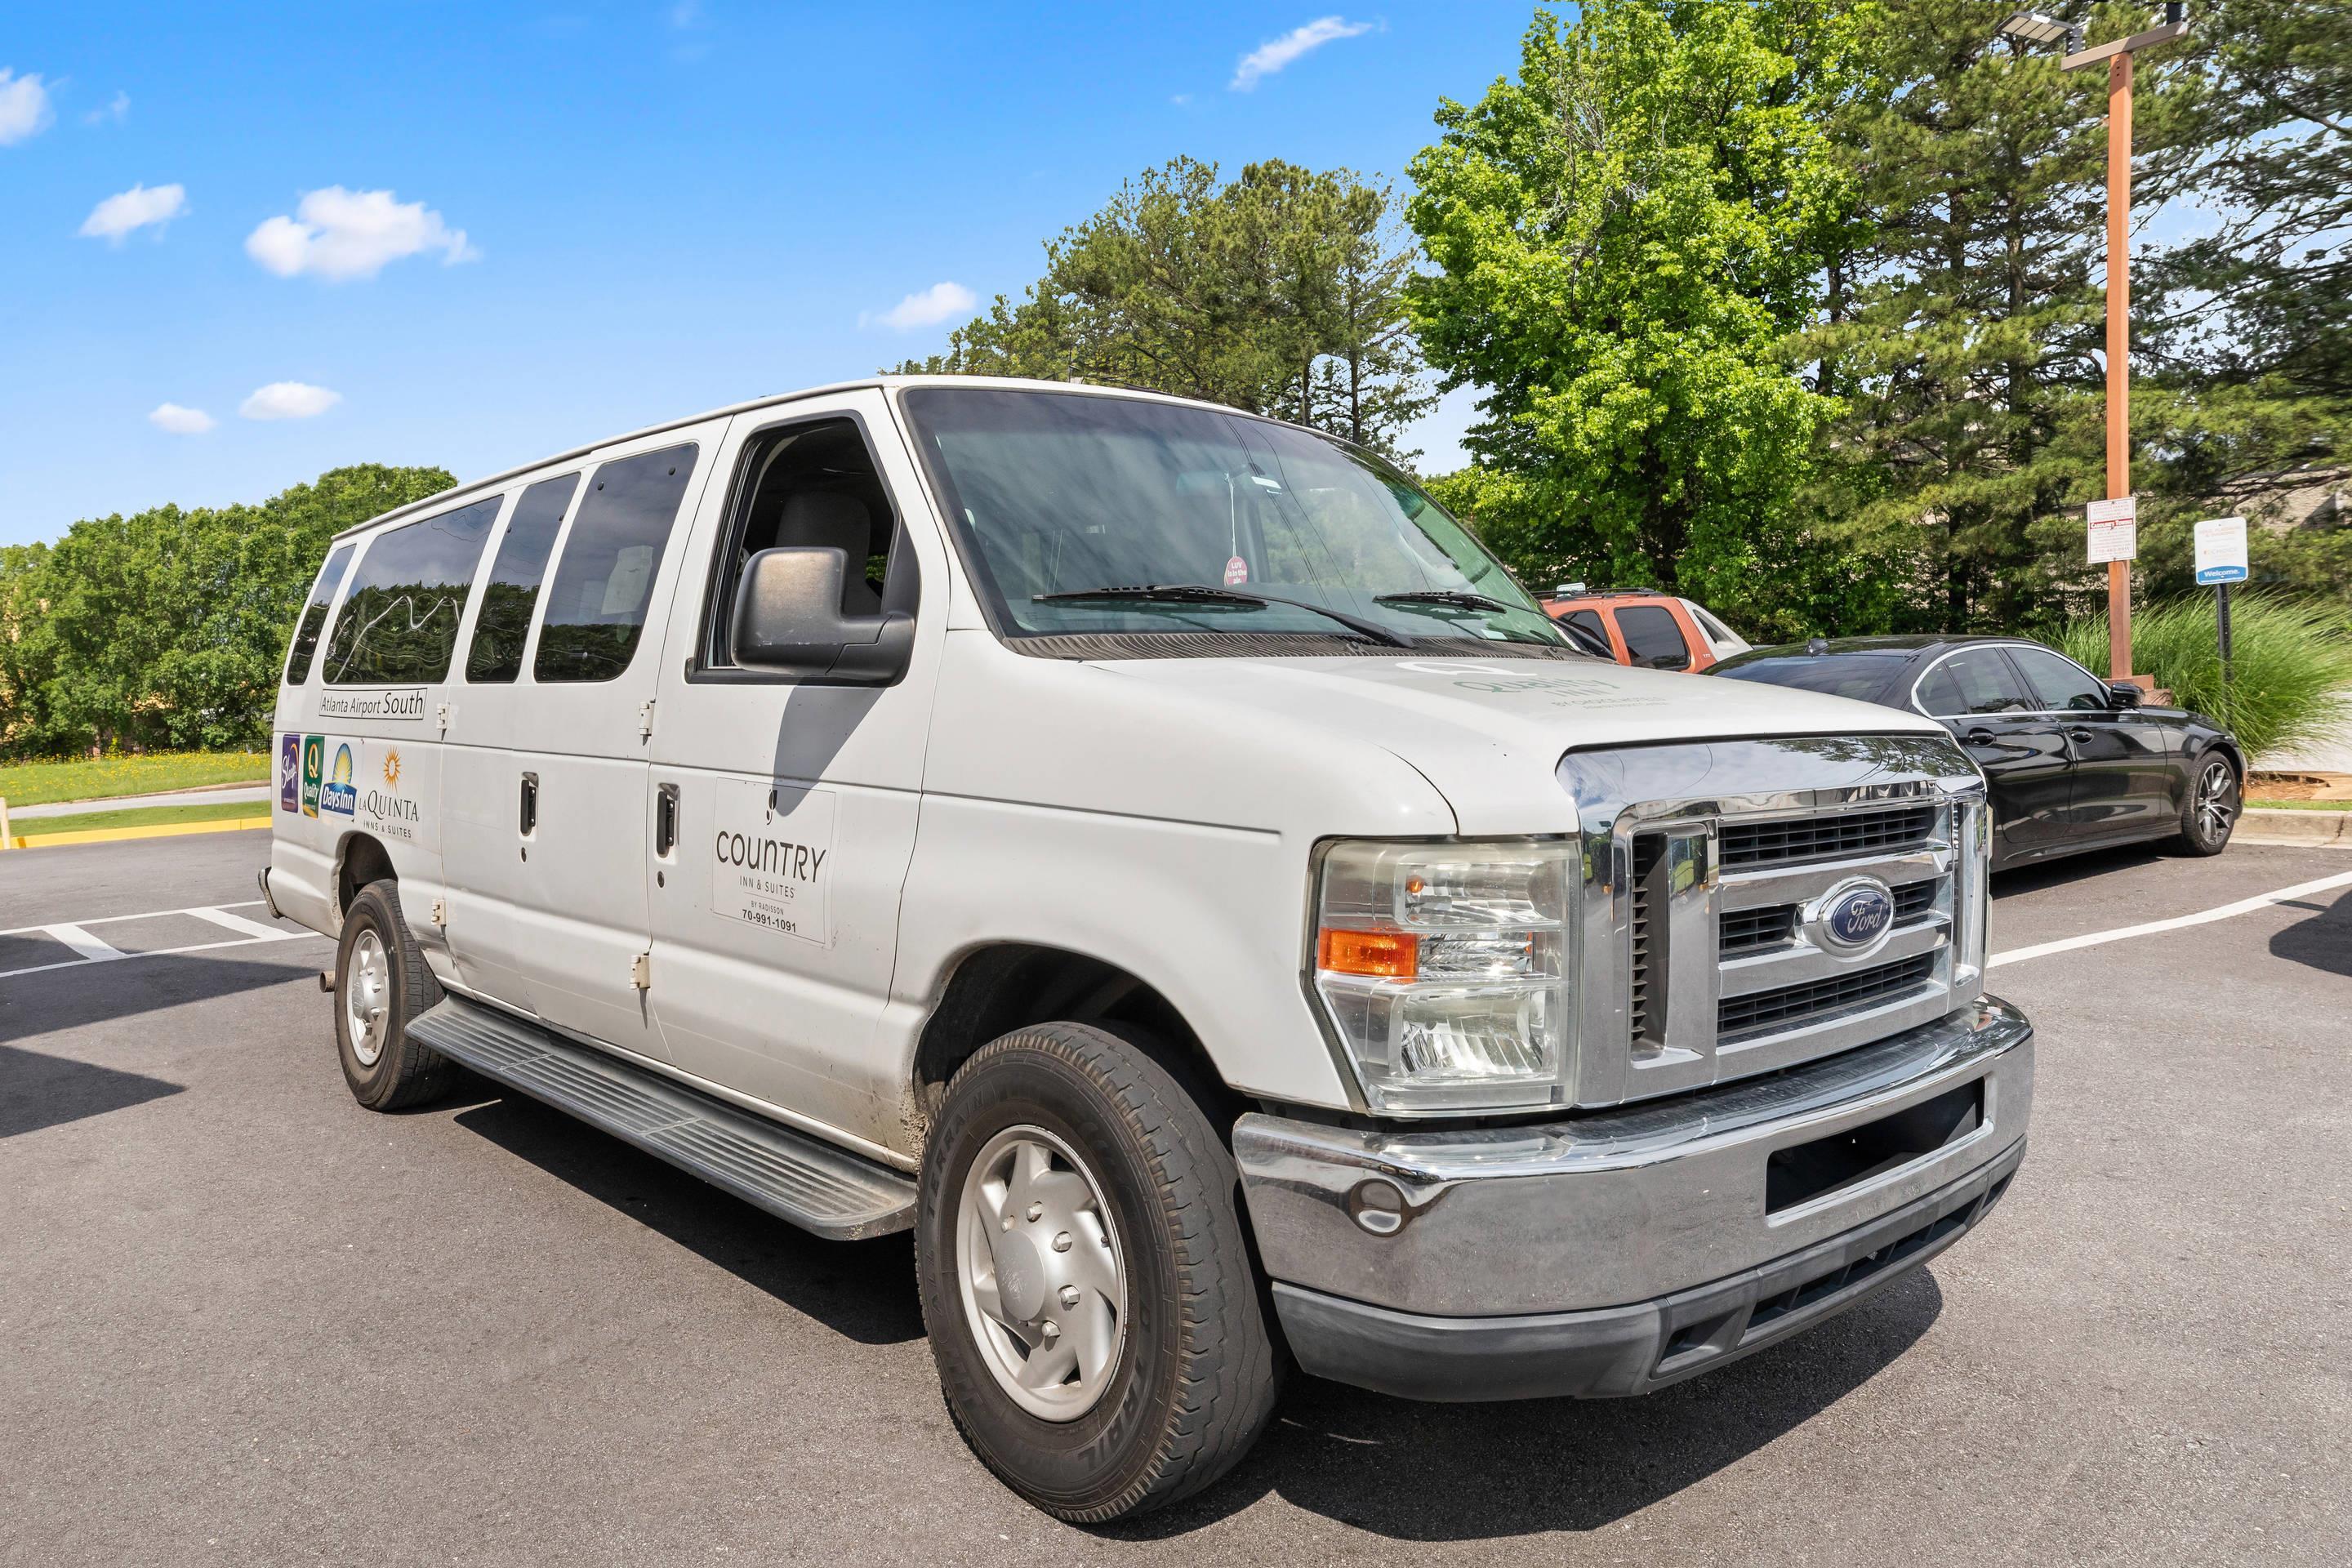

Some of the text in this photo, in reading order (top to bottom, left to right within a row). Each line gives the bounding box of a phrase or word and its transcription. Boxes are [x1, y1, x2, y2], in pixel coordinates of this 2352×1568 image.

[1232, 561, 1242, 569] LUV
[321, 690, 424, 717] Atlanta Airport South
[281, 754, 297, 790] Sleep
[303, 782, 319, 803] Quality
[323, 786, 354, 810] Days Inn
[359, 790, 418, 822] LA QUINTA
[363, 819, 378, 831] INNS
[388, 825, 412, 838] SUITES
[740, 875, 795, 898] INN & SUITES
[751, 900, 784, 915] BY RADISSON
[1847, 900, 1886, 933] Ford
[742, 909, 796, 933] 70-991-1091
